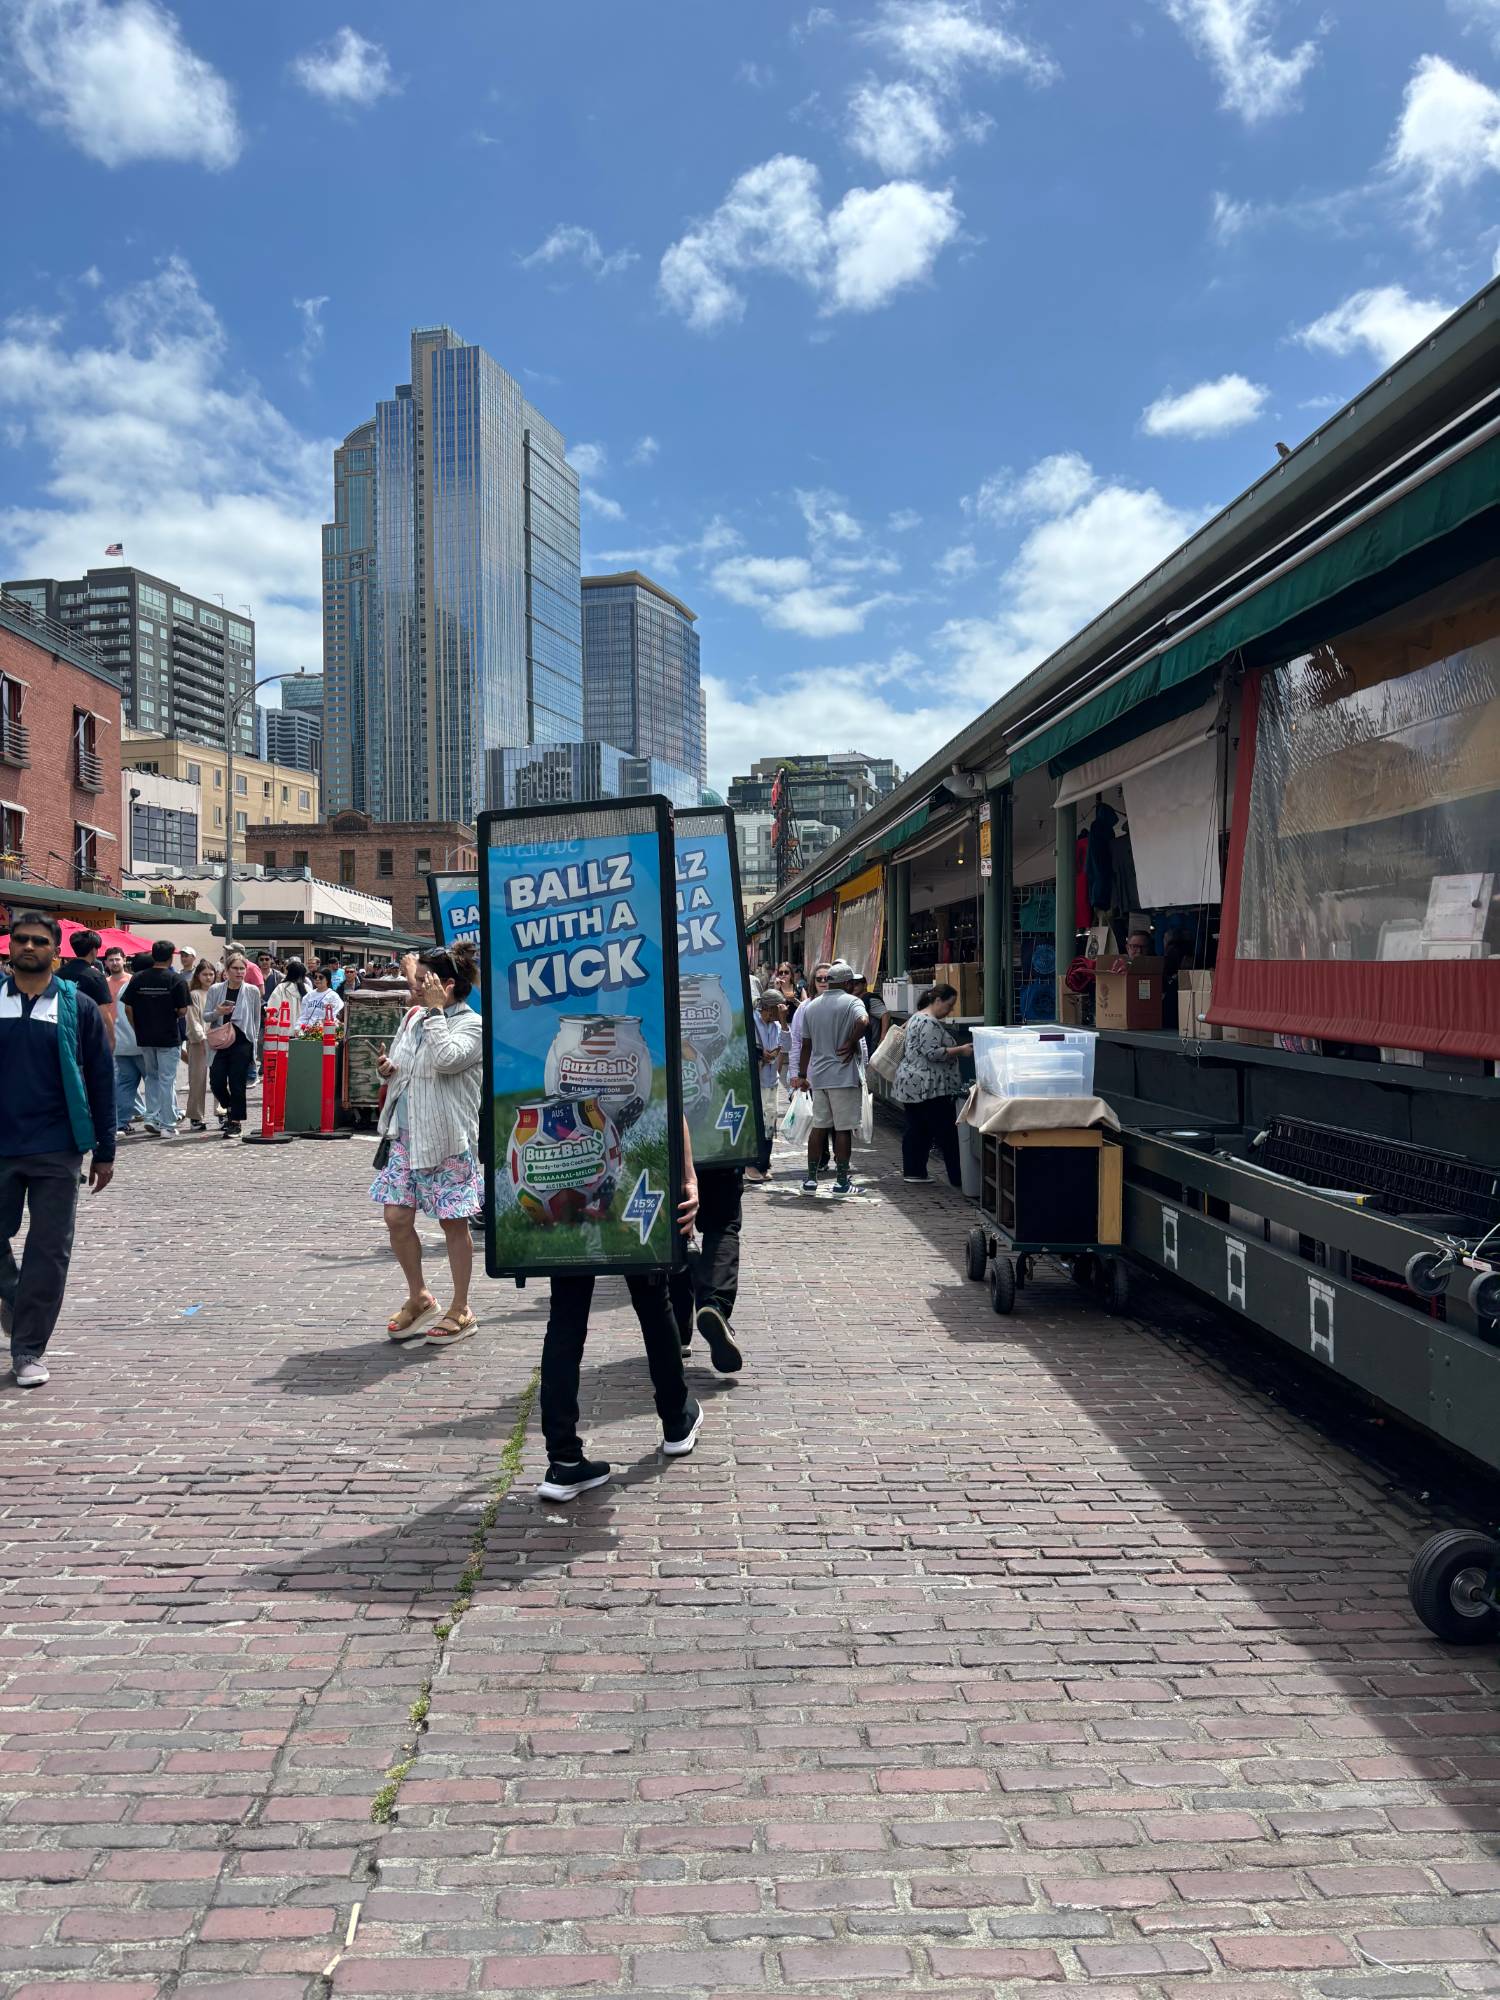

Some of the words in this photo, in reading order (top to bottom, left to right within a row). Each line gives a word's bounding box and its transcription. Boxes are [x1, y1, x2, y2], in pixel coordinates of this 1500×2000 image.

[509, 854, 633, 911] BALLZ
[514, 906, 603, 949] WITH
[610, 901, 637, 930] A
[515, 937, 647, 1003] KICK
[561, 1058, 637, 1078] BuzzBallz
[724, 1111, 742, 1120] 15%
[525, 1138, 602, 1162] BuzzBallz
[633, 1198, 656, 1209] 15%
